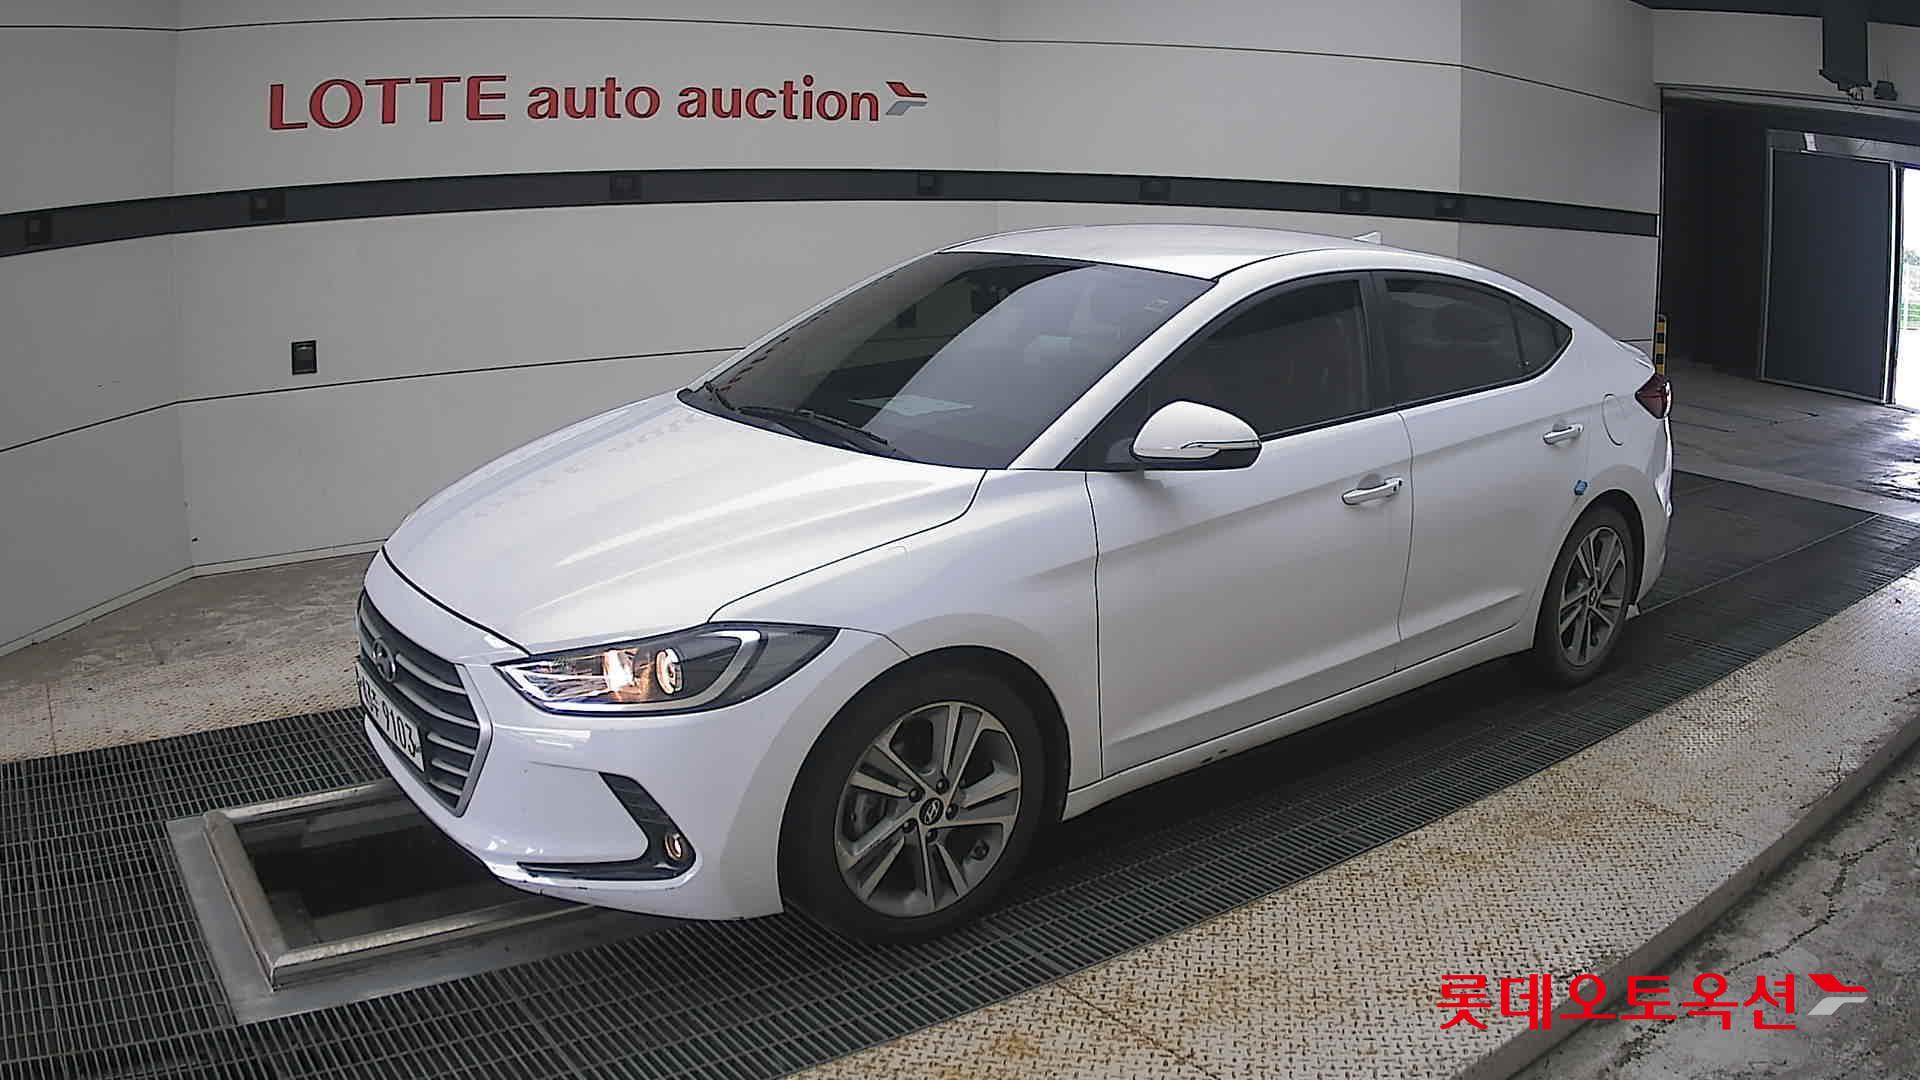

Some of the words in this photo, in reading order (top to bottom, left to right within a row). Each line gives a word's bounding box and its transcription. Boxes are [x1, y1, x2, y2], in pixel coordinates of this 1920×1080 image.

[270, 75, 506, 130] LOTTE
[527, 77, 660, 120] auto
[677, 75, 879, 121] auction
